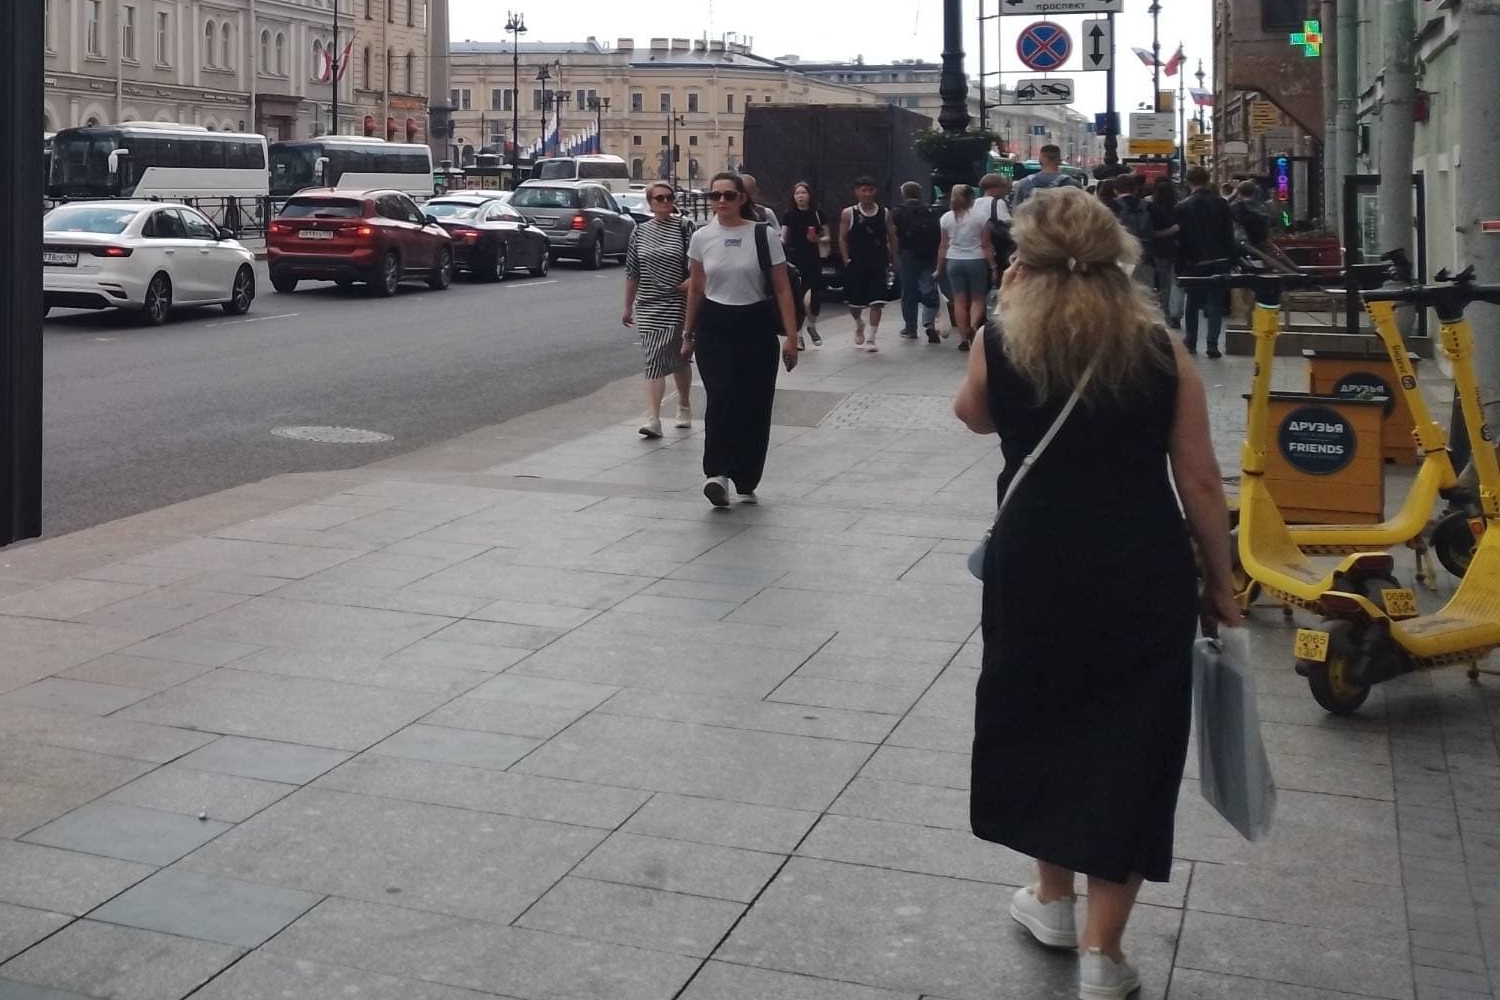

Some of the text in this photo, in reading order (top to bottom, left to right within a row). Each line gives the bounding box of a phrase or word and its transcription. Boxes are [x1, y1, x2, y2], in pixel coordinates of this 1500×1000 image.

[1036, 2, 1086, 11] проспект
[1340, 384, 1384, 394] ДРУЗЬЯ
[1288, 421, 1344, 434] ДРУЗЬЯ
[1288, 442, 1345, 455] FRIENDS
